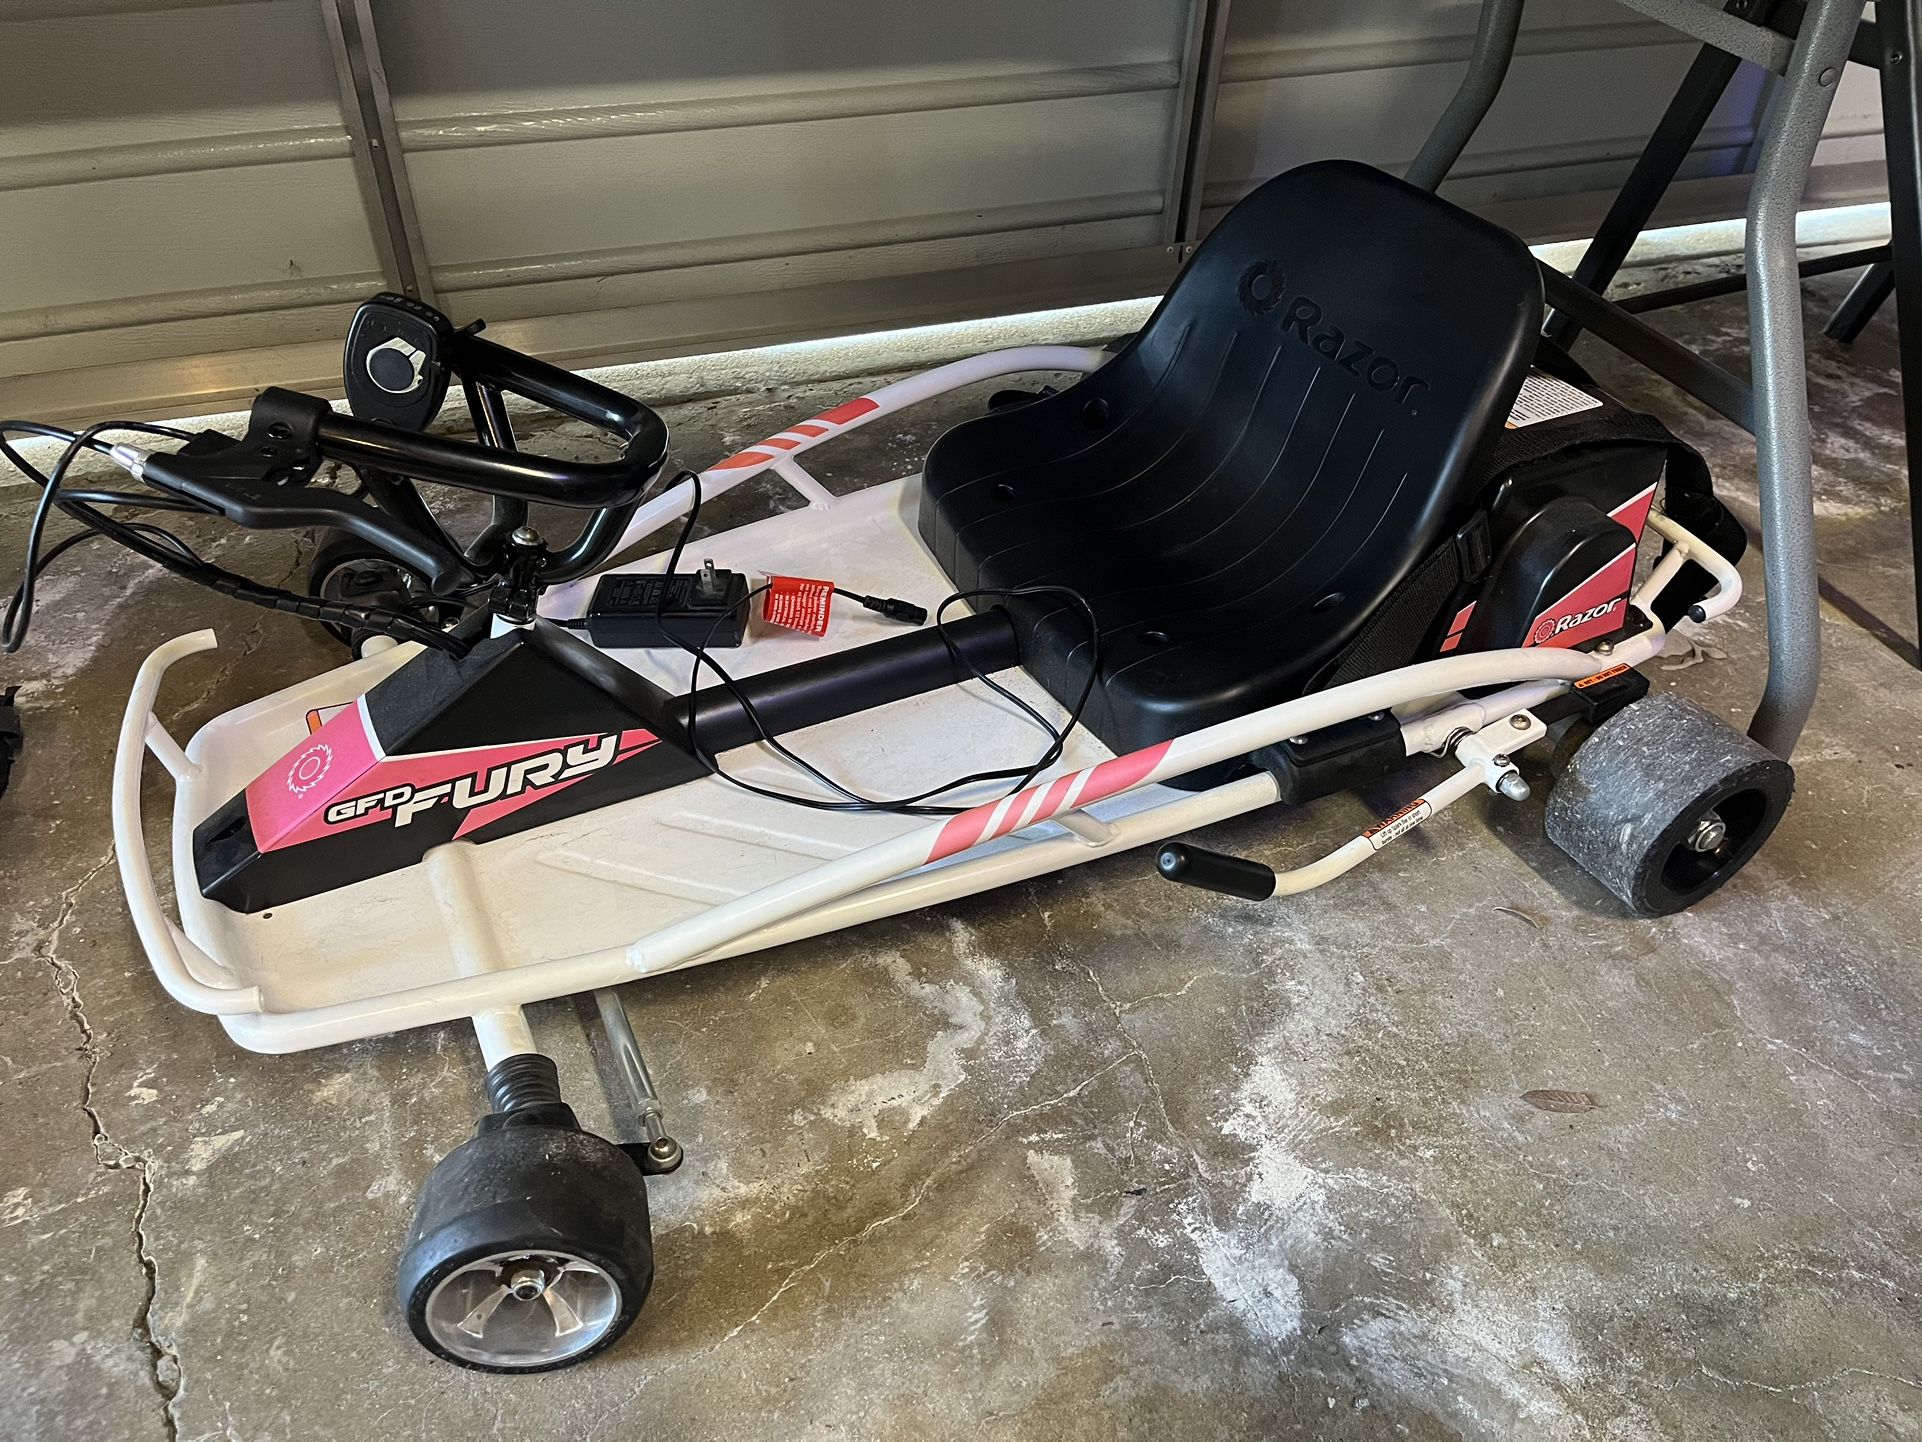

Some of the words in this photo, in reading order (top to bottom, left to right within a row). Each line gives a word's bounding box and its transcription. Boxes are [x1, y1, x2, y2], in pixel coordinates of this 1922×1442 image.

[1280, 295, 1431, 404] Razor
[811, 596, 819, 612] power
[813, 585, 830, 633] REMINDER
[1555, 598, 1621, 634] Razor
[327, 785, 412, 823] GFD
[394, 734, 617, 828] FURY
